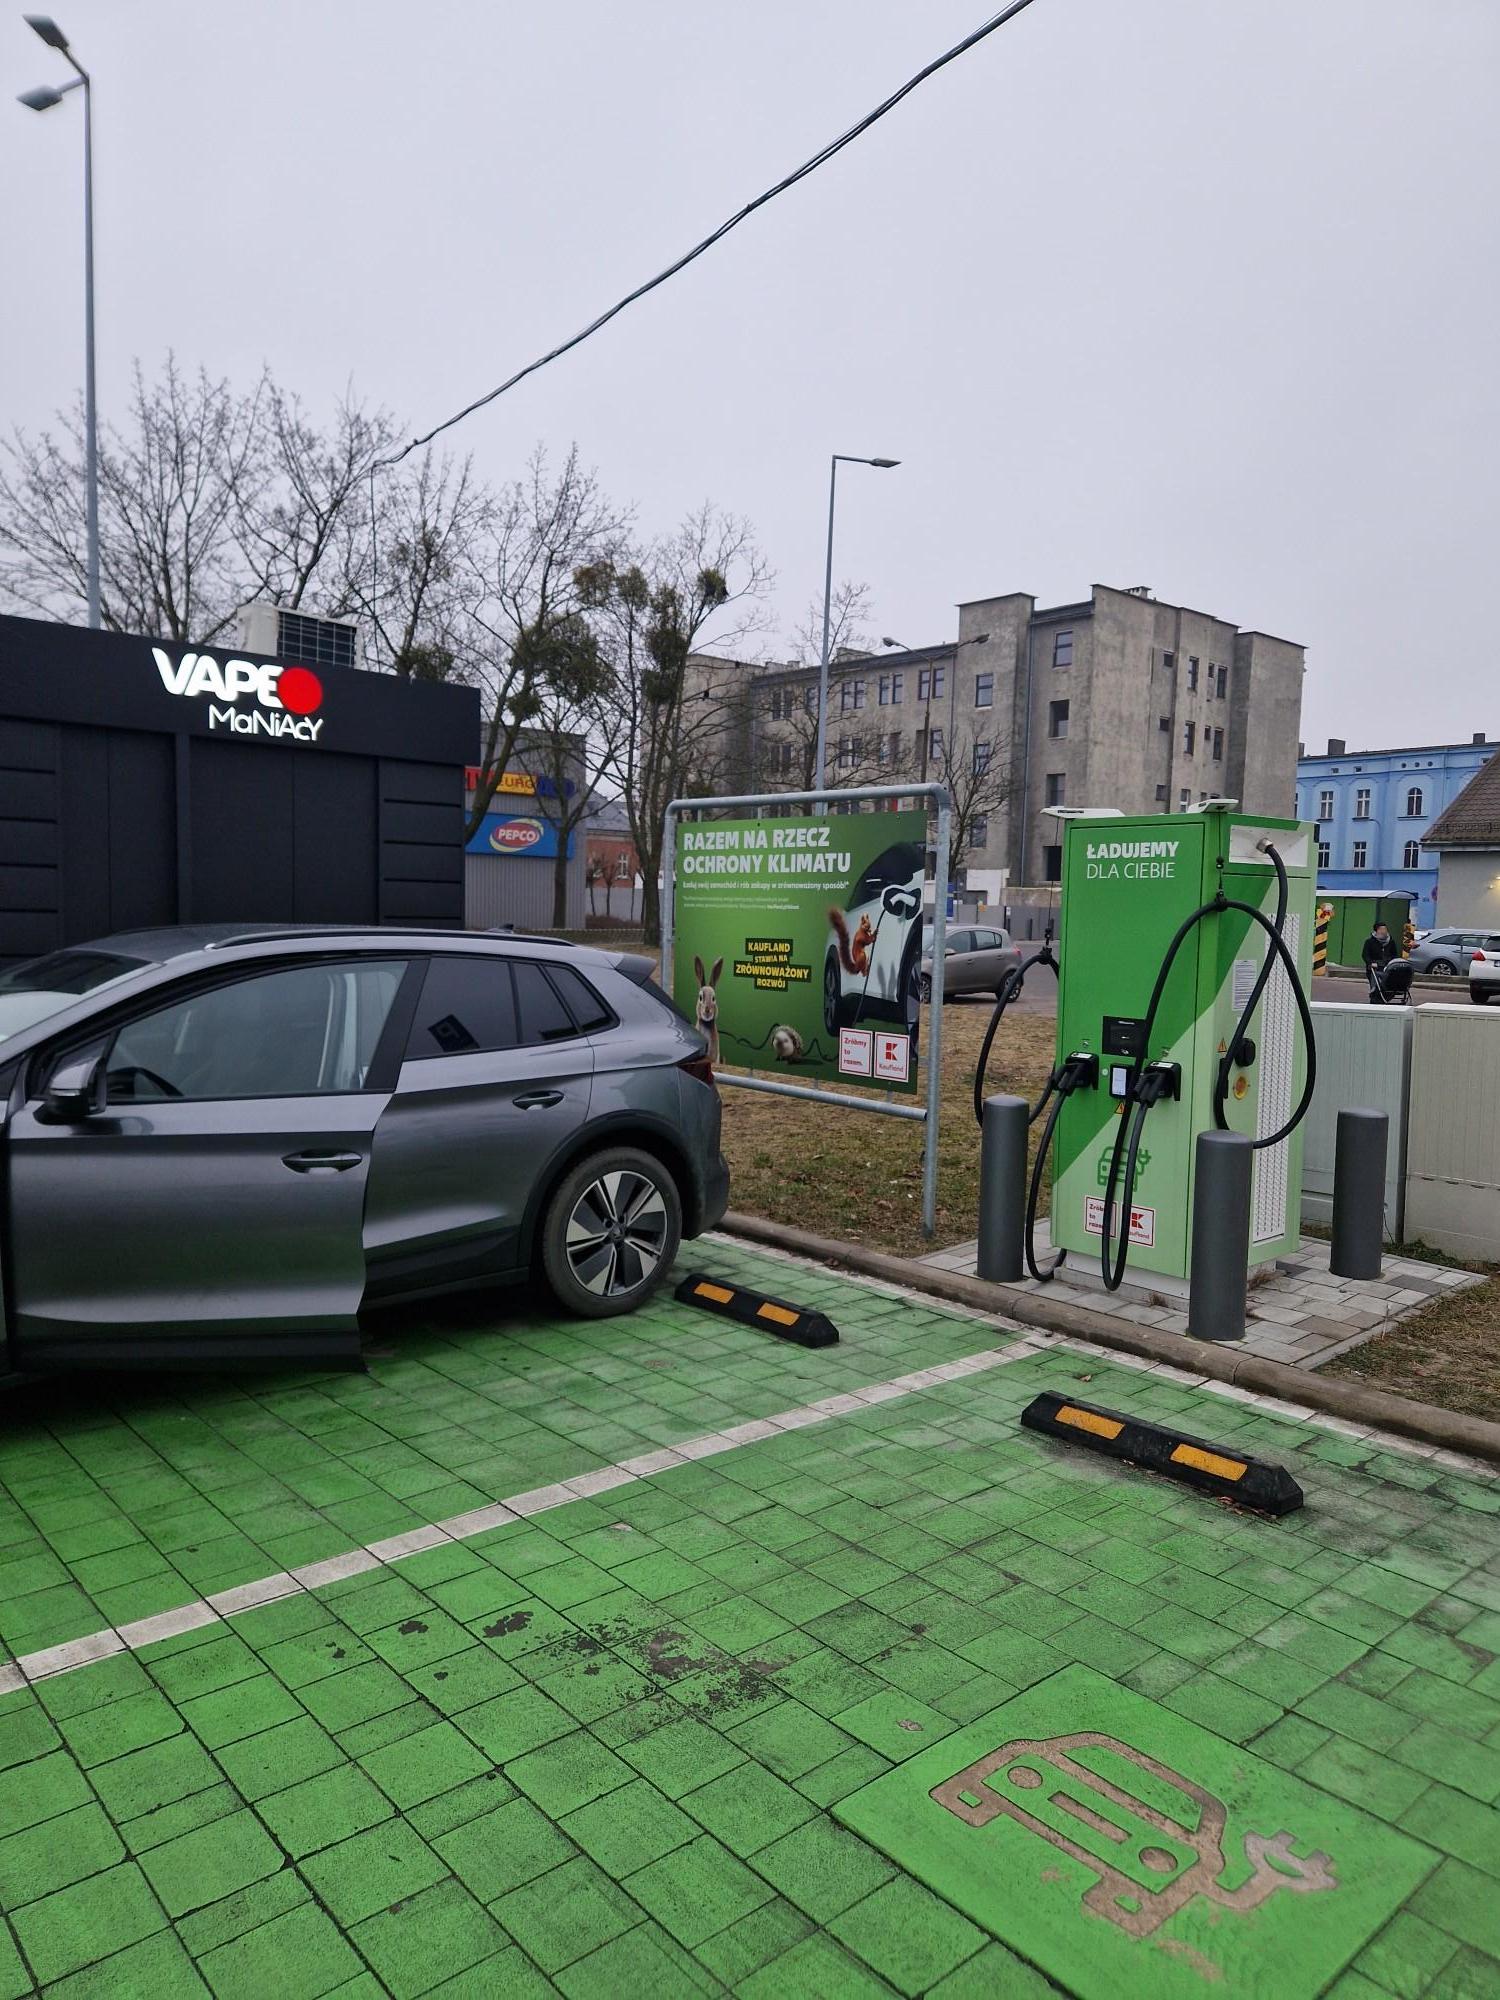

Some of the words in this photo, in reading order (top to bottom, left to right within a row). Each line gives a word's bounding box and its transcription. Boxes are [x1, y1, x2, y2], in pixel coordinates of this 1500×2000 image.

[151, 647, 284, 708] VAPE
[498, 828, 537, 841] PEPCO
[684, 831, 739, 850] RAZEM
[744, 830, 768, 849] NA
[773, 827, 830, 847] RZECZ
[1087, 841, 1179, 859] ŁADUJEMY
[683, 855, 763, 874] OCHRONY
[768, 852, 850, 873] KLIMATU
[1087, 863, 1120, 879] DLA
[1124, 862, 1176, 878] CIEBIE
[748, 942, 790, 952] KAUFLAND
[736, 963, 809, 979] ZRÓWNOWAŻONY
[757, 978, 786, 988] ROZWÓJ
